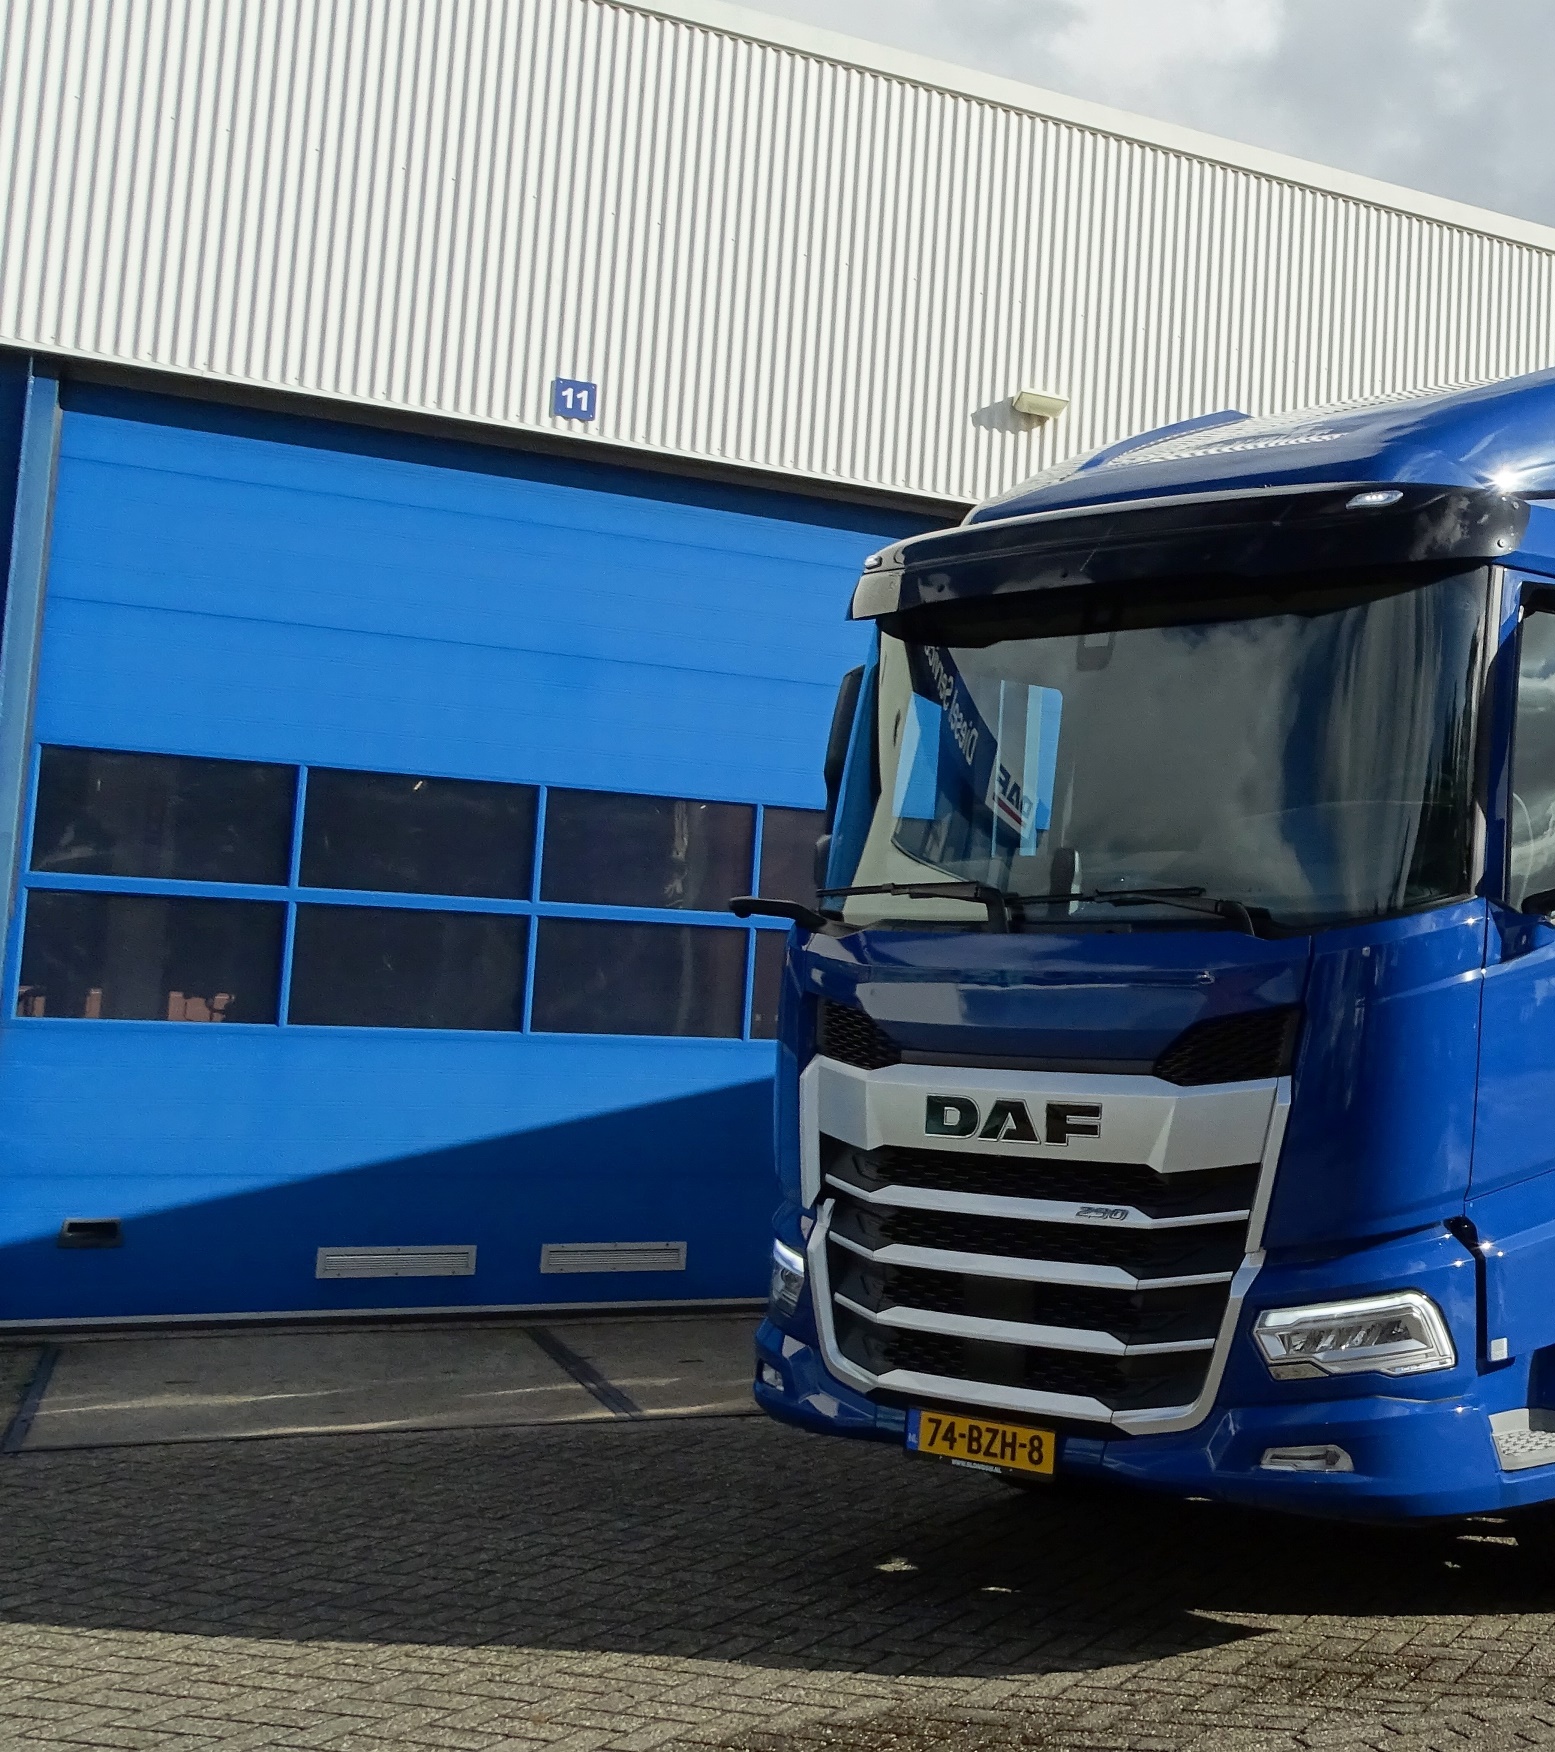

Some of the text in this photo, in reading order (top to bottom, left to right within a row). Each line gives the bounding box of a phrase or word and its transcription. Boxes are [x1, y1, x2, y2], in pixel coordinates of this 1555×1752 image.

[561, 388, 588, 411] 11
[925, 1093, 1102, 1146] DAF
[1076, 1206, 1130, 1221] 290
[928, 1417, 1044, 1465] 74-BZH-8
